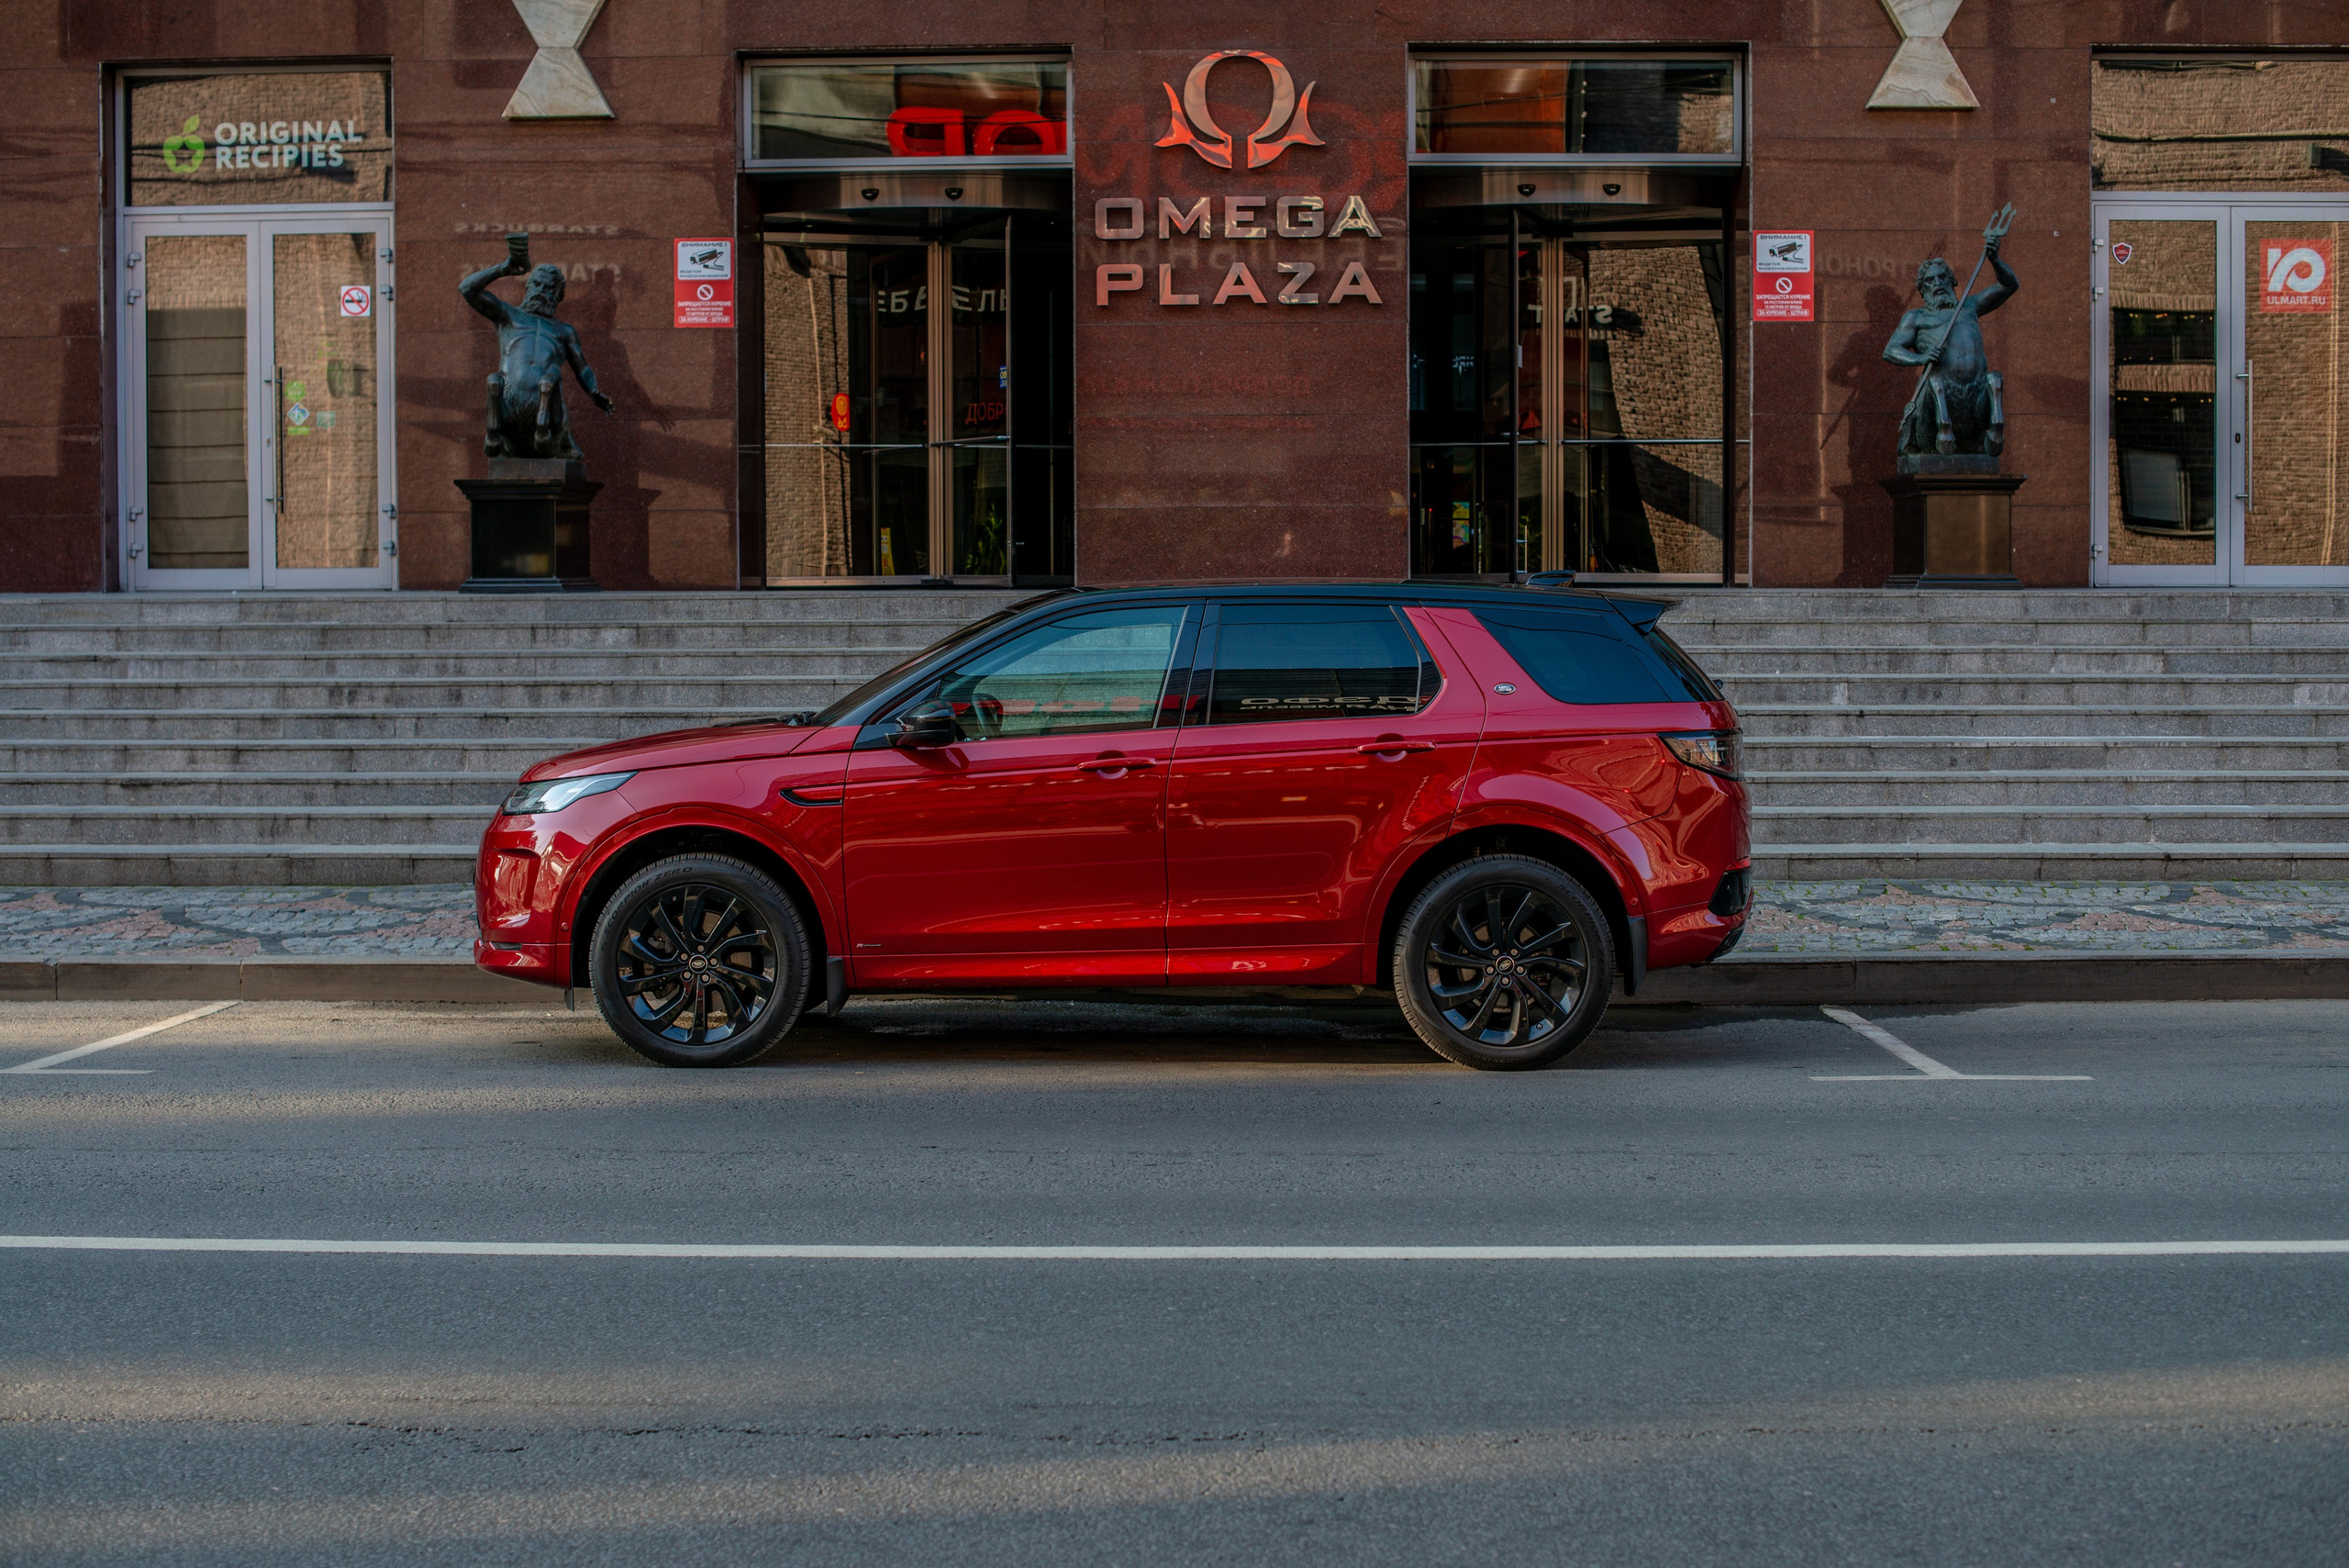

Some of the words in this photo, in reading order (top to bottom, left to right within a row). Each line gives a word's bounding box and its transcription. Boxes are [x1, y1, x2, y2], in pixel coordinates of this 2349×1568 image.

[214, 120, 363, 145] ORIGINAL
[216, 144, 344, 169] RECIPIES
[1095, 195, 1383, 239] OMEGA
[1096, 262, 1383, 306] PLAZA
[2266, 295, 2326, 306] ULMART.RU
[964, 402, 1008, 425] ДОБР
[654, 866, 693, 881] ZERO
